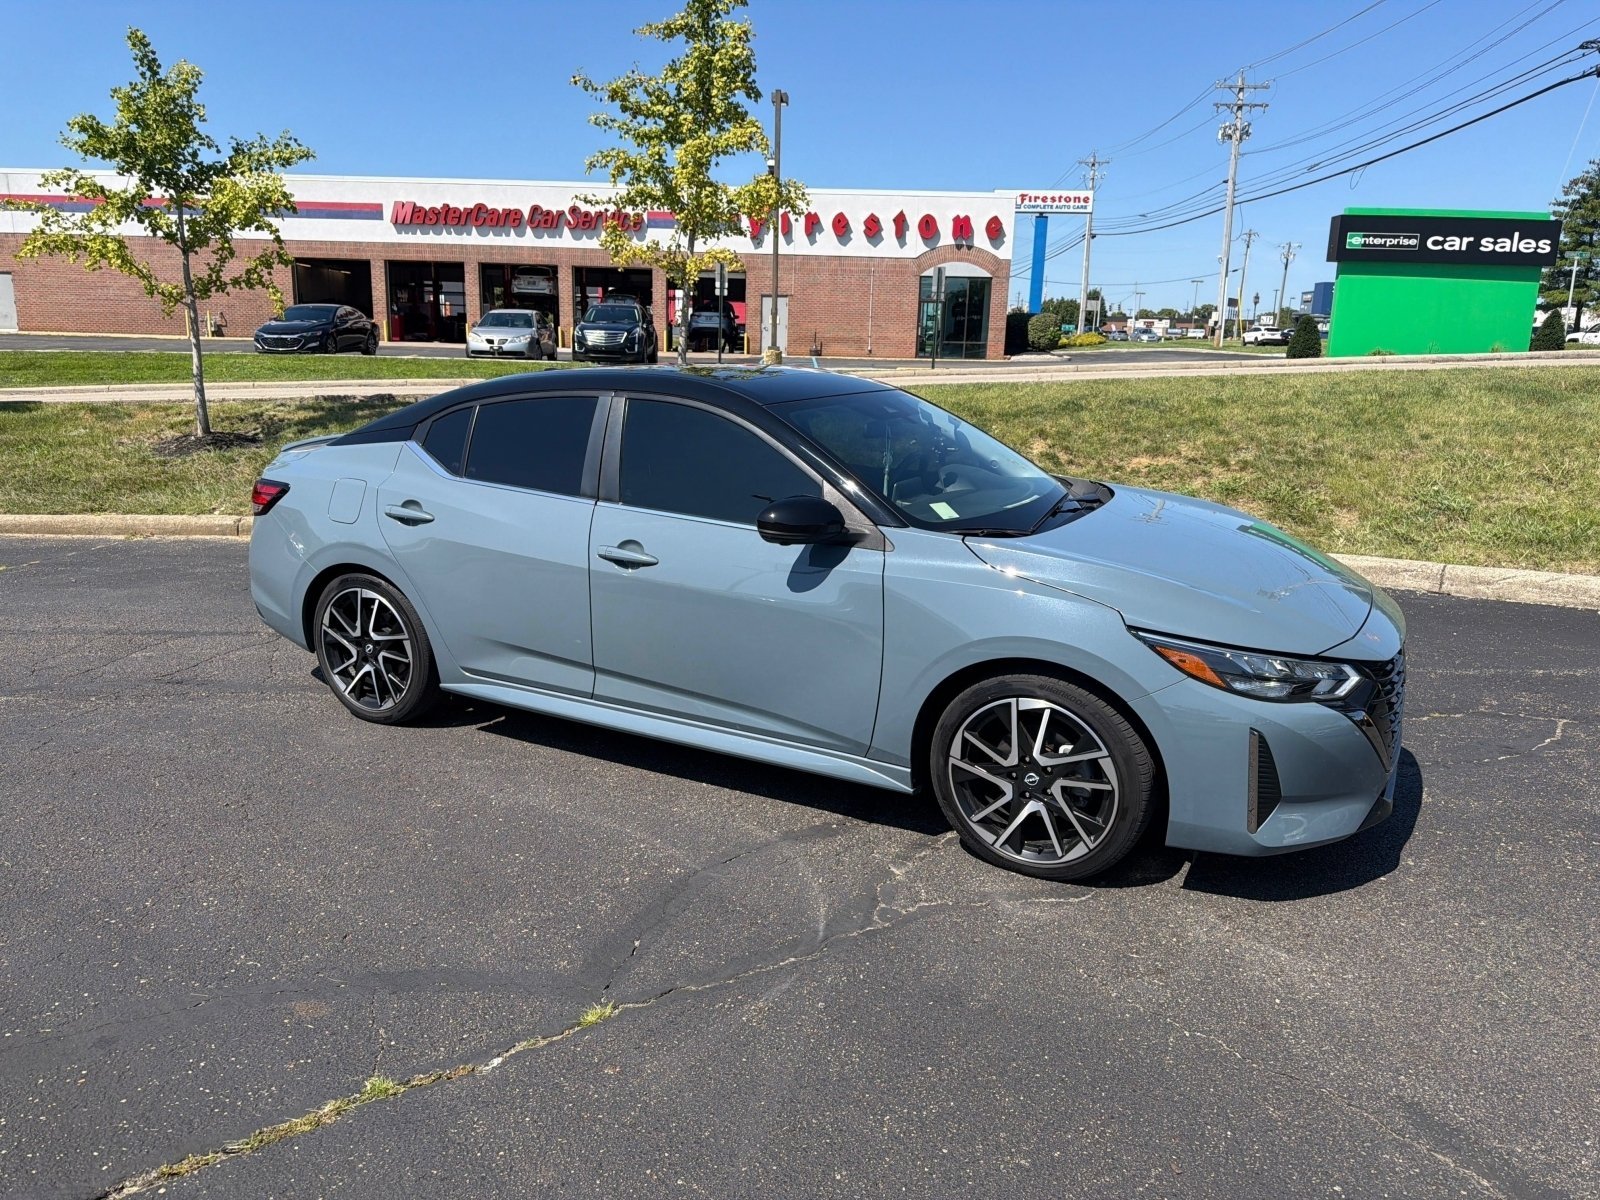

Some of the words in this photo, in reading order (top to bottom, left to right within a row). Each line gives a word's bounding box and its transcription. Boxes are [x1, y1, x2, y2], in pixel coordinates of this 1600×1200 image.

[1019, 193, 1090, 204] Firestone
[390, 201, 522, 228] MasterCare
[526, 204, 564, 228] Car
[1351, 236, 1417, 247] enterprise
[1426, 235, 1474, 251] car
[1479, 231, 1552, 254] sales
